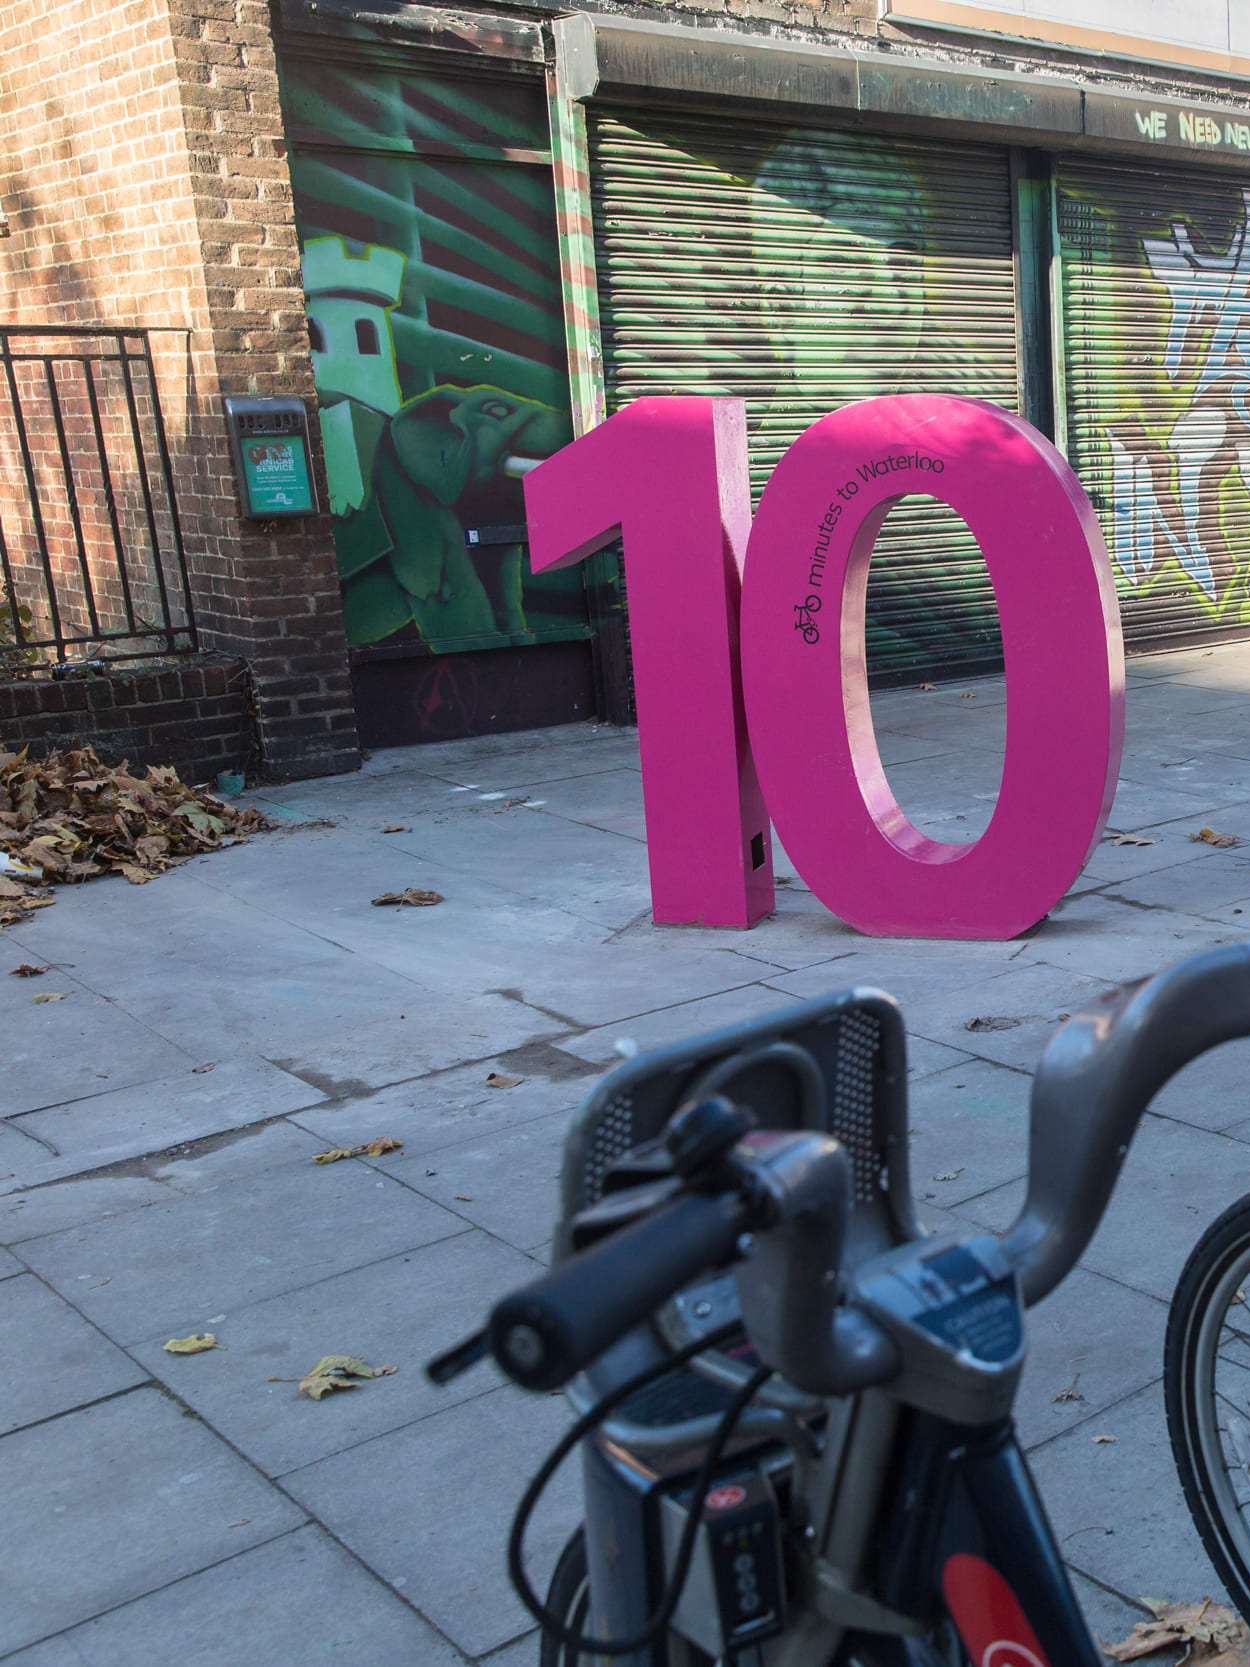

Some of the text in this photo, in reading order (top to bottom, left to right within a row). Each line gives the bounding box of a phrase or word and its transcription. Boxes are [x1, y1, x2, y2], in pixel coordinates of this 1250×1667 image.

[1135, 108, 1167, 139] WE
[1179, 111, 1221, 145] NEED
[256, 464, 295, 472] SERVICE
[809, 450, 944, 586] minutes to Waterloo
[523, 393, 1126, 940] 10
